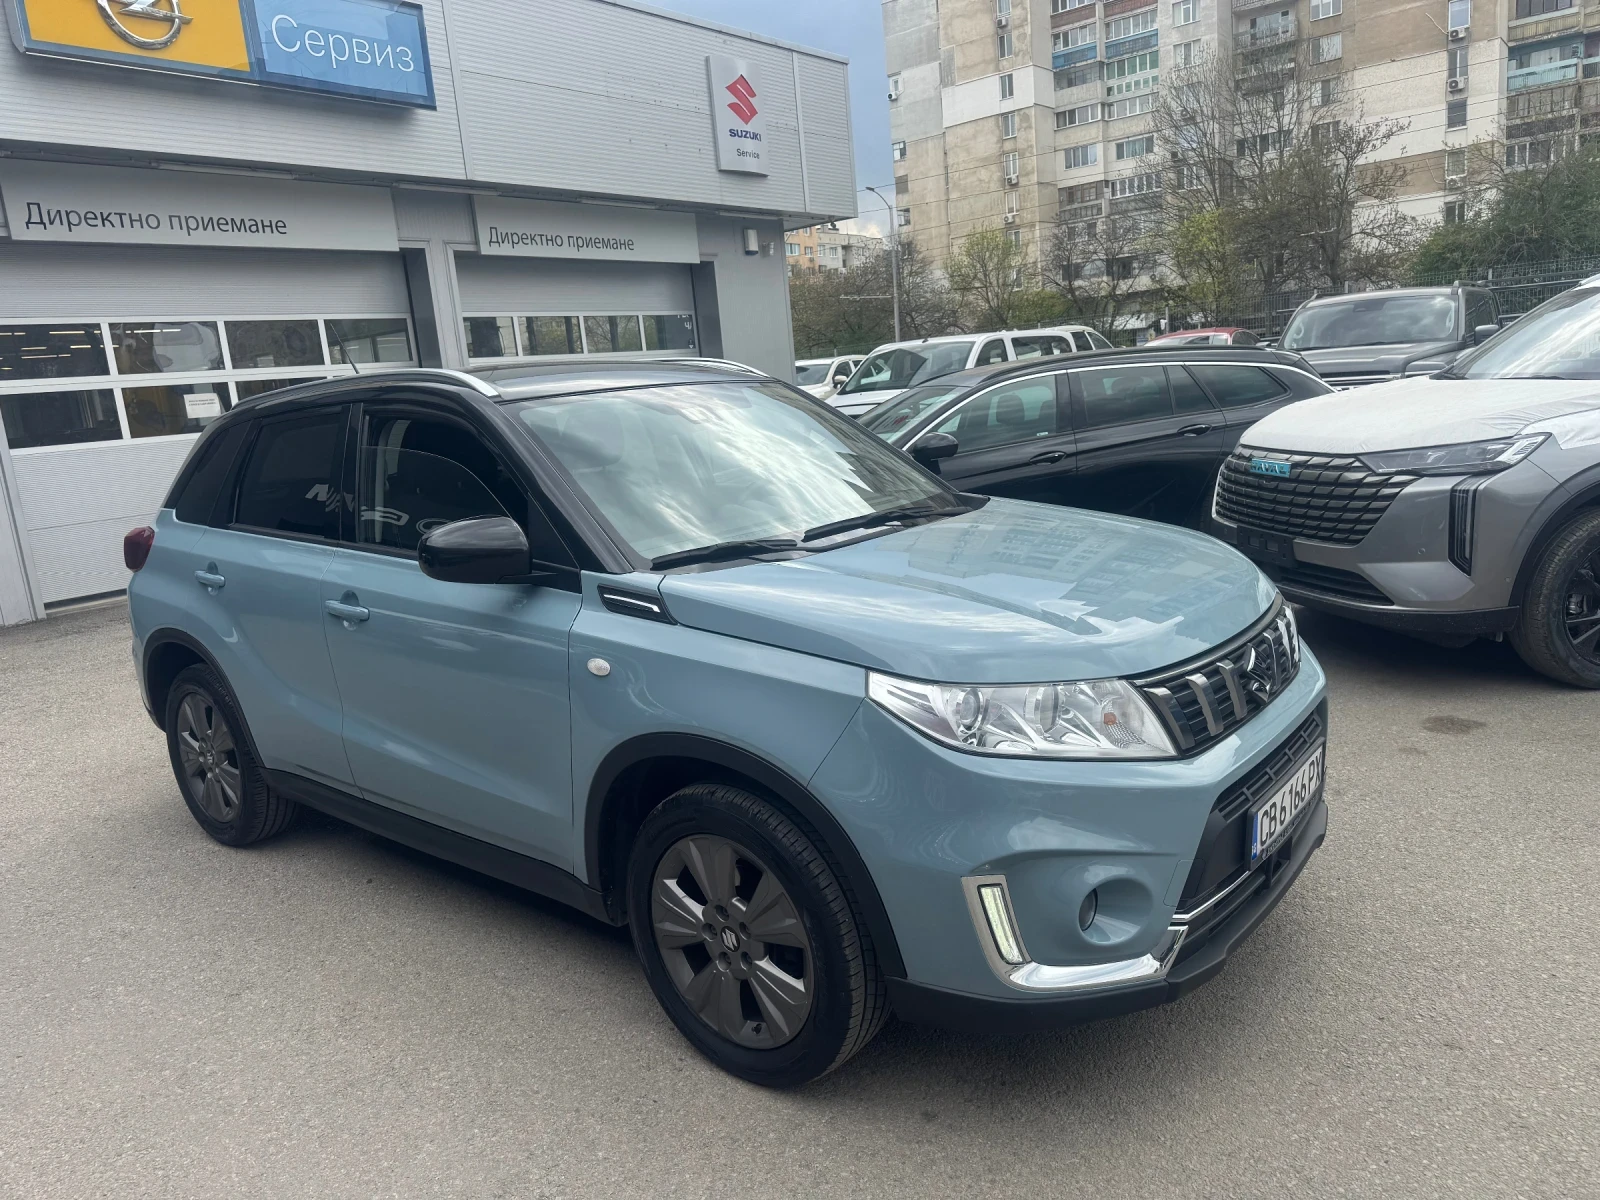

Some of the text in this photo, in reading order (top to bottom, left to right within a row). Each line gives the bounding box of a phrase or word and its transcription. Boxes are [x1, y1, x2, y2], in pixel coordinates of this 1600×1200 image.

[271, 14, 414, 72] Сервиз
[728, 128, 762, 142] SUZUKI
[736, 148, 760, 159] Service
[25, 202, 288, 236] Директно приемане
[489, 226, 634, 252] Директно приемане
